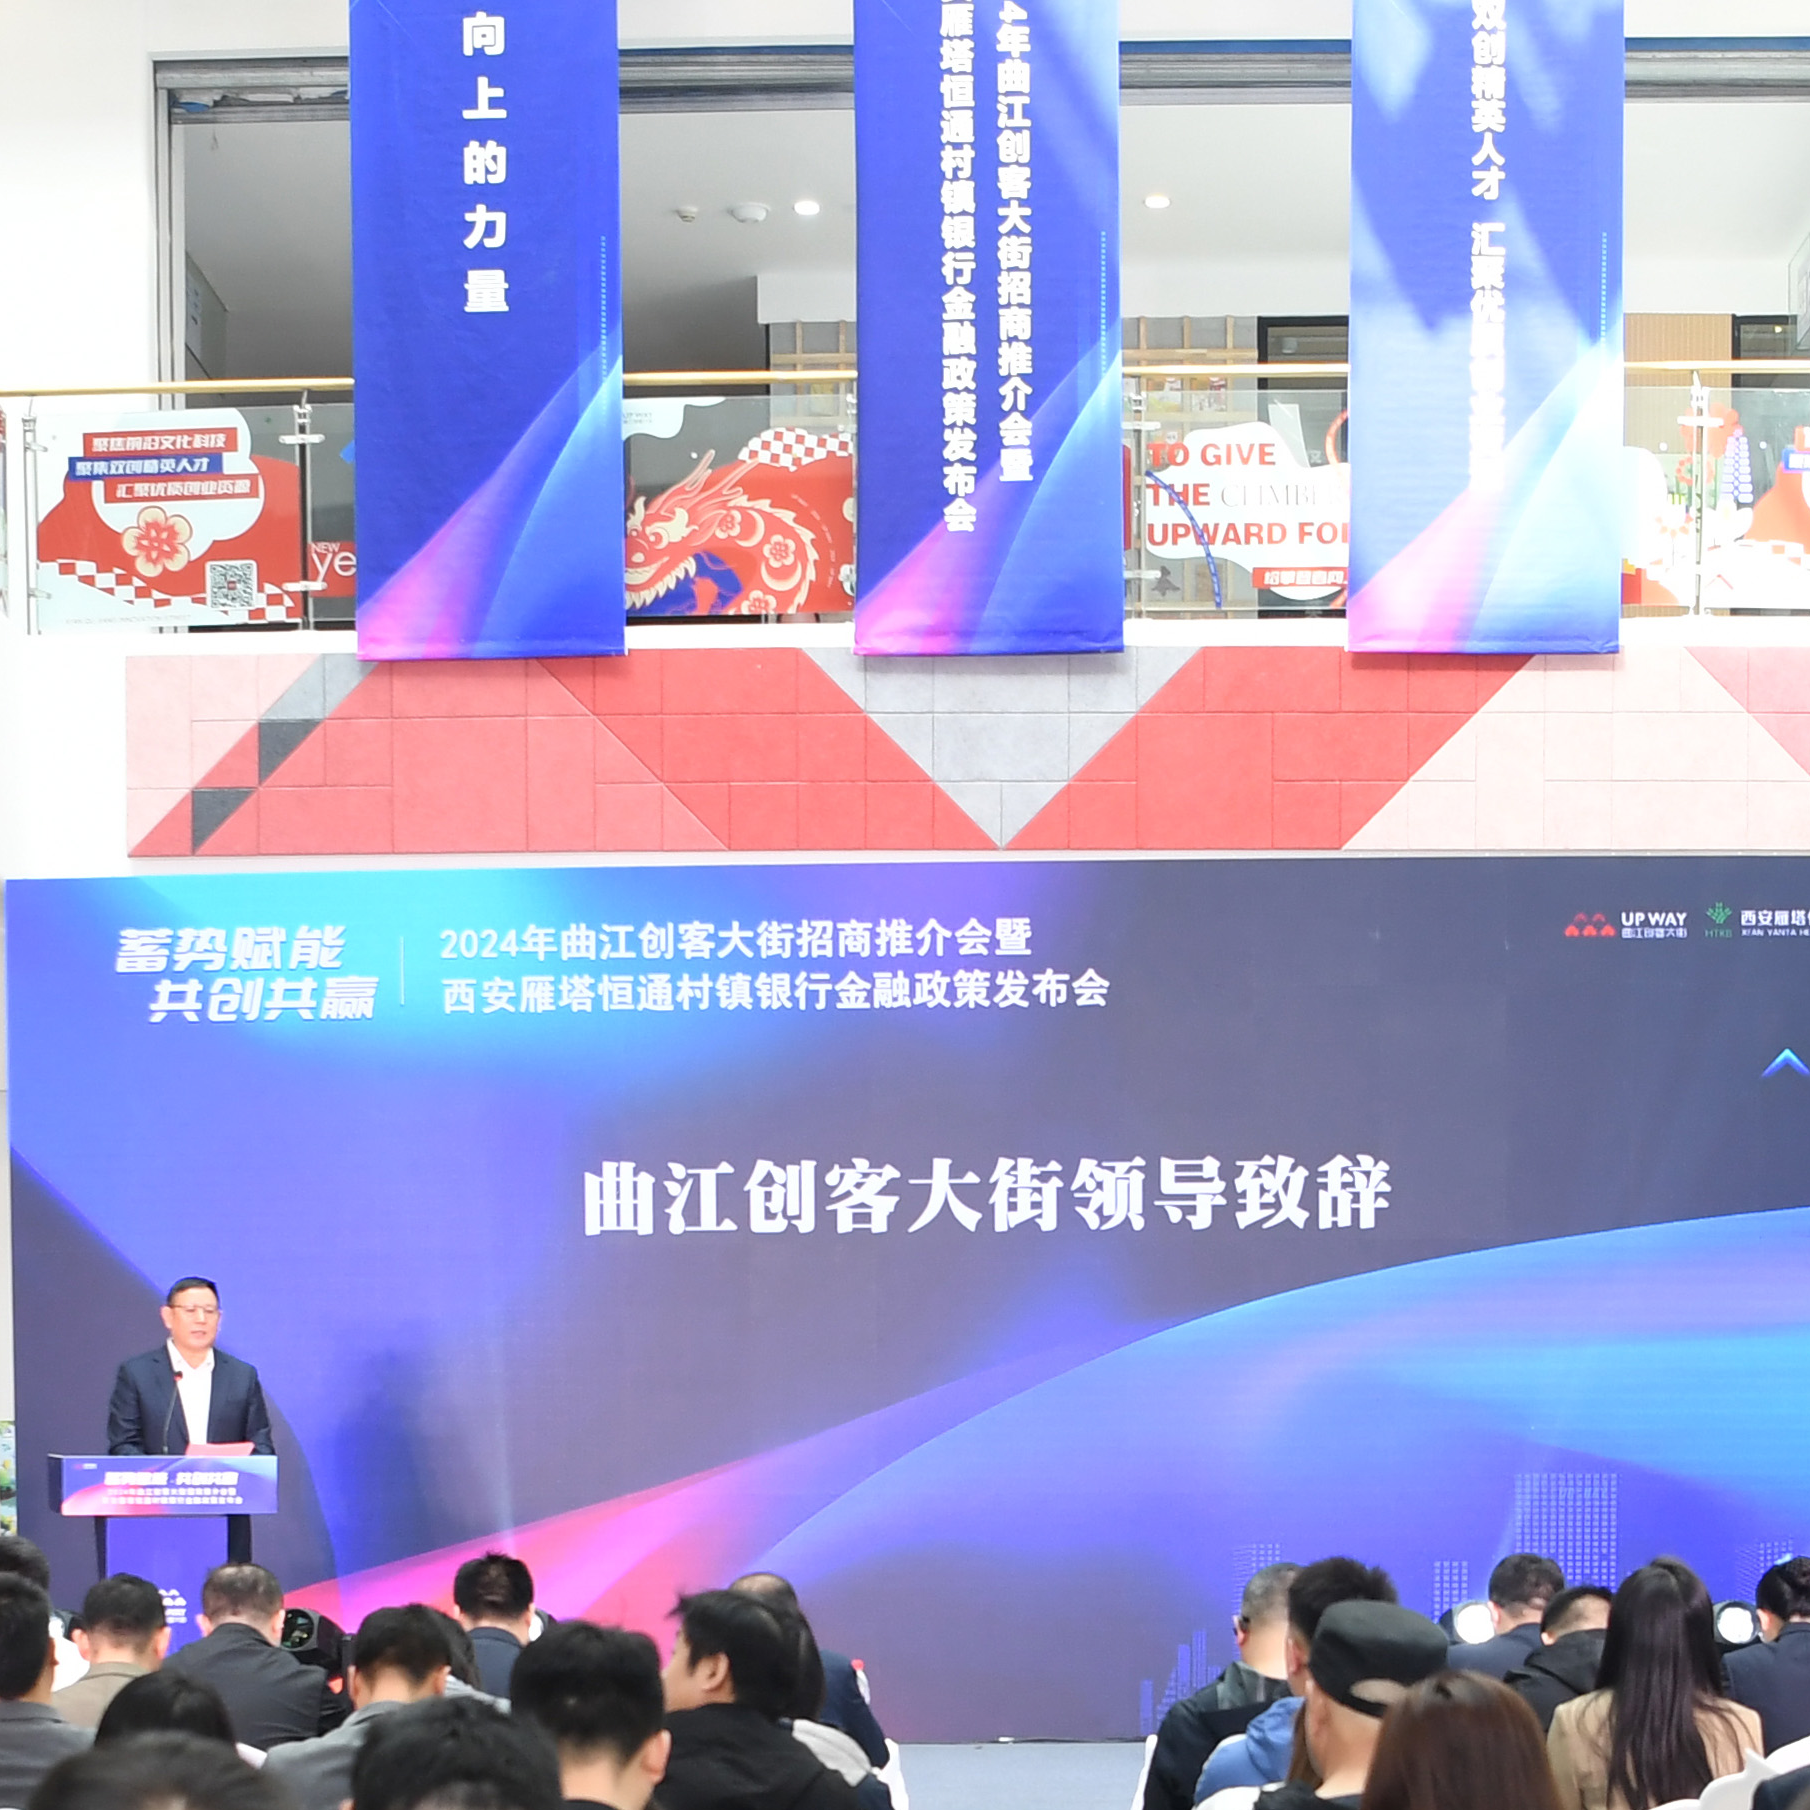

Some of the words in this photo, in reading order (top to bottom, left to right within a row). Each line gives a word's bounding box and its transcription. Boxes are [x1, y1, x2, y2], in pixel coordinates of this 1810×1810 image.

[462, 11, 510, 313] 向上的力量
[939, 0, 977, 532] 雁塔恒通村镇银行金融政策发布会
[1147, 443, 1189, 467] TO
[1200, 443, 1276, 466] GIVE
[1145, 483, 1210, 506] THE
[311, 542, 340, 552] NEW
[1147, 523, 1287, 546] UPWARD
[440, 916, 1033, 962] 2024年曲江创客大街招商推介会暨
[1621, 911, 1644, 927] UP
[1648, 911, 1688, 927] WAY
[115, 925, 347, 974] 蓄势赋能
[148, 975, 380, 1023] 共创共赢
[441, 967, 1111, 1015] 西安雁塔恒通村镇银行金融政策发布会
[582, 1151, 1394, 1236] 曲江创客大街领导致辞
